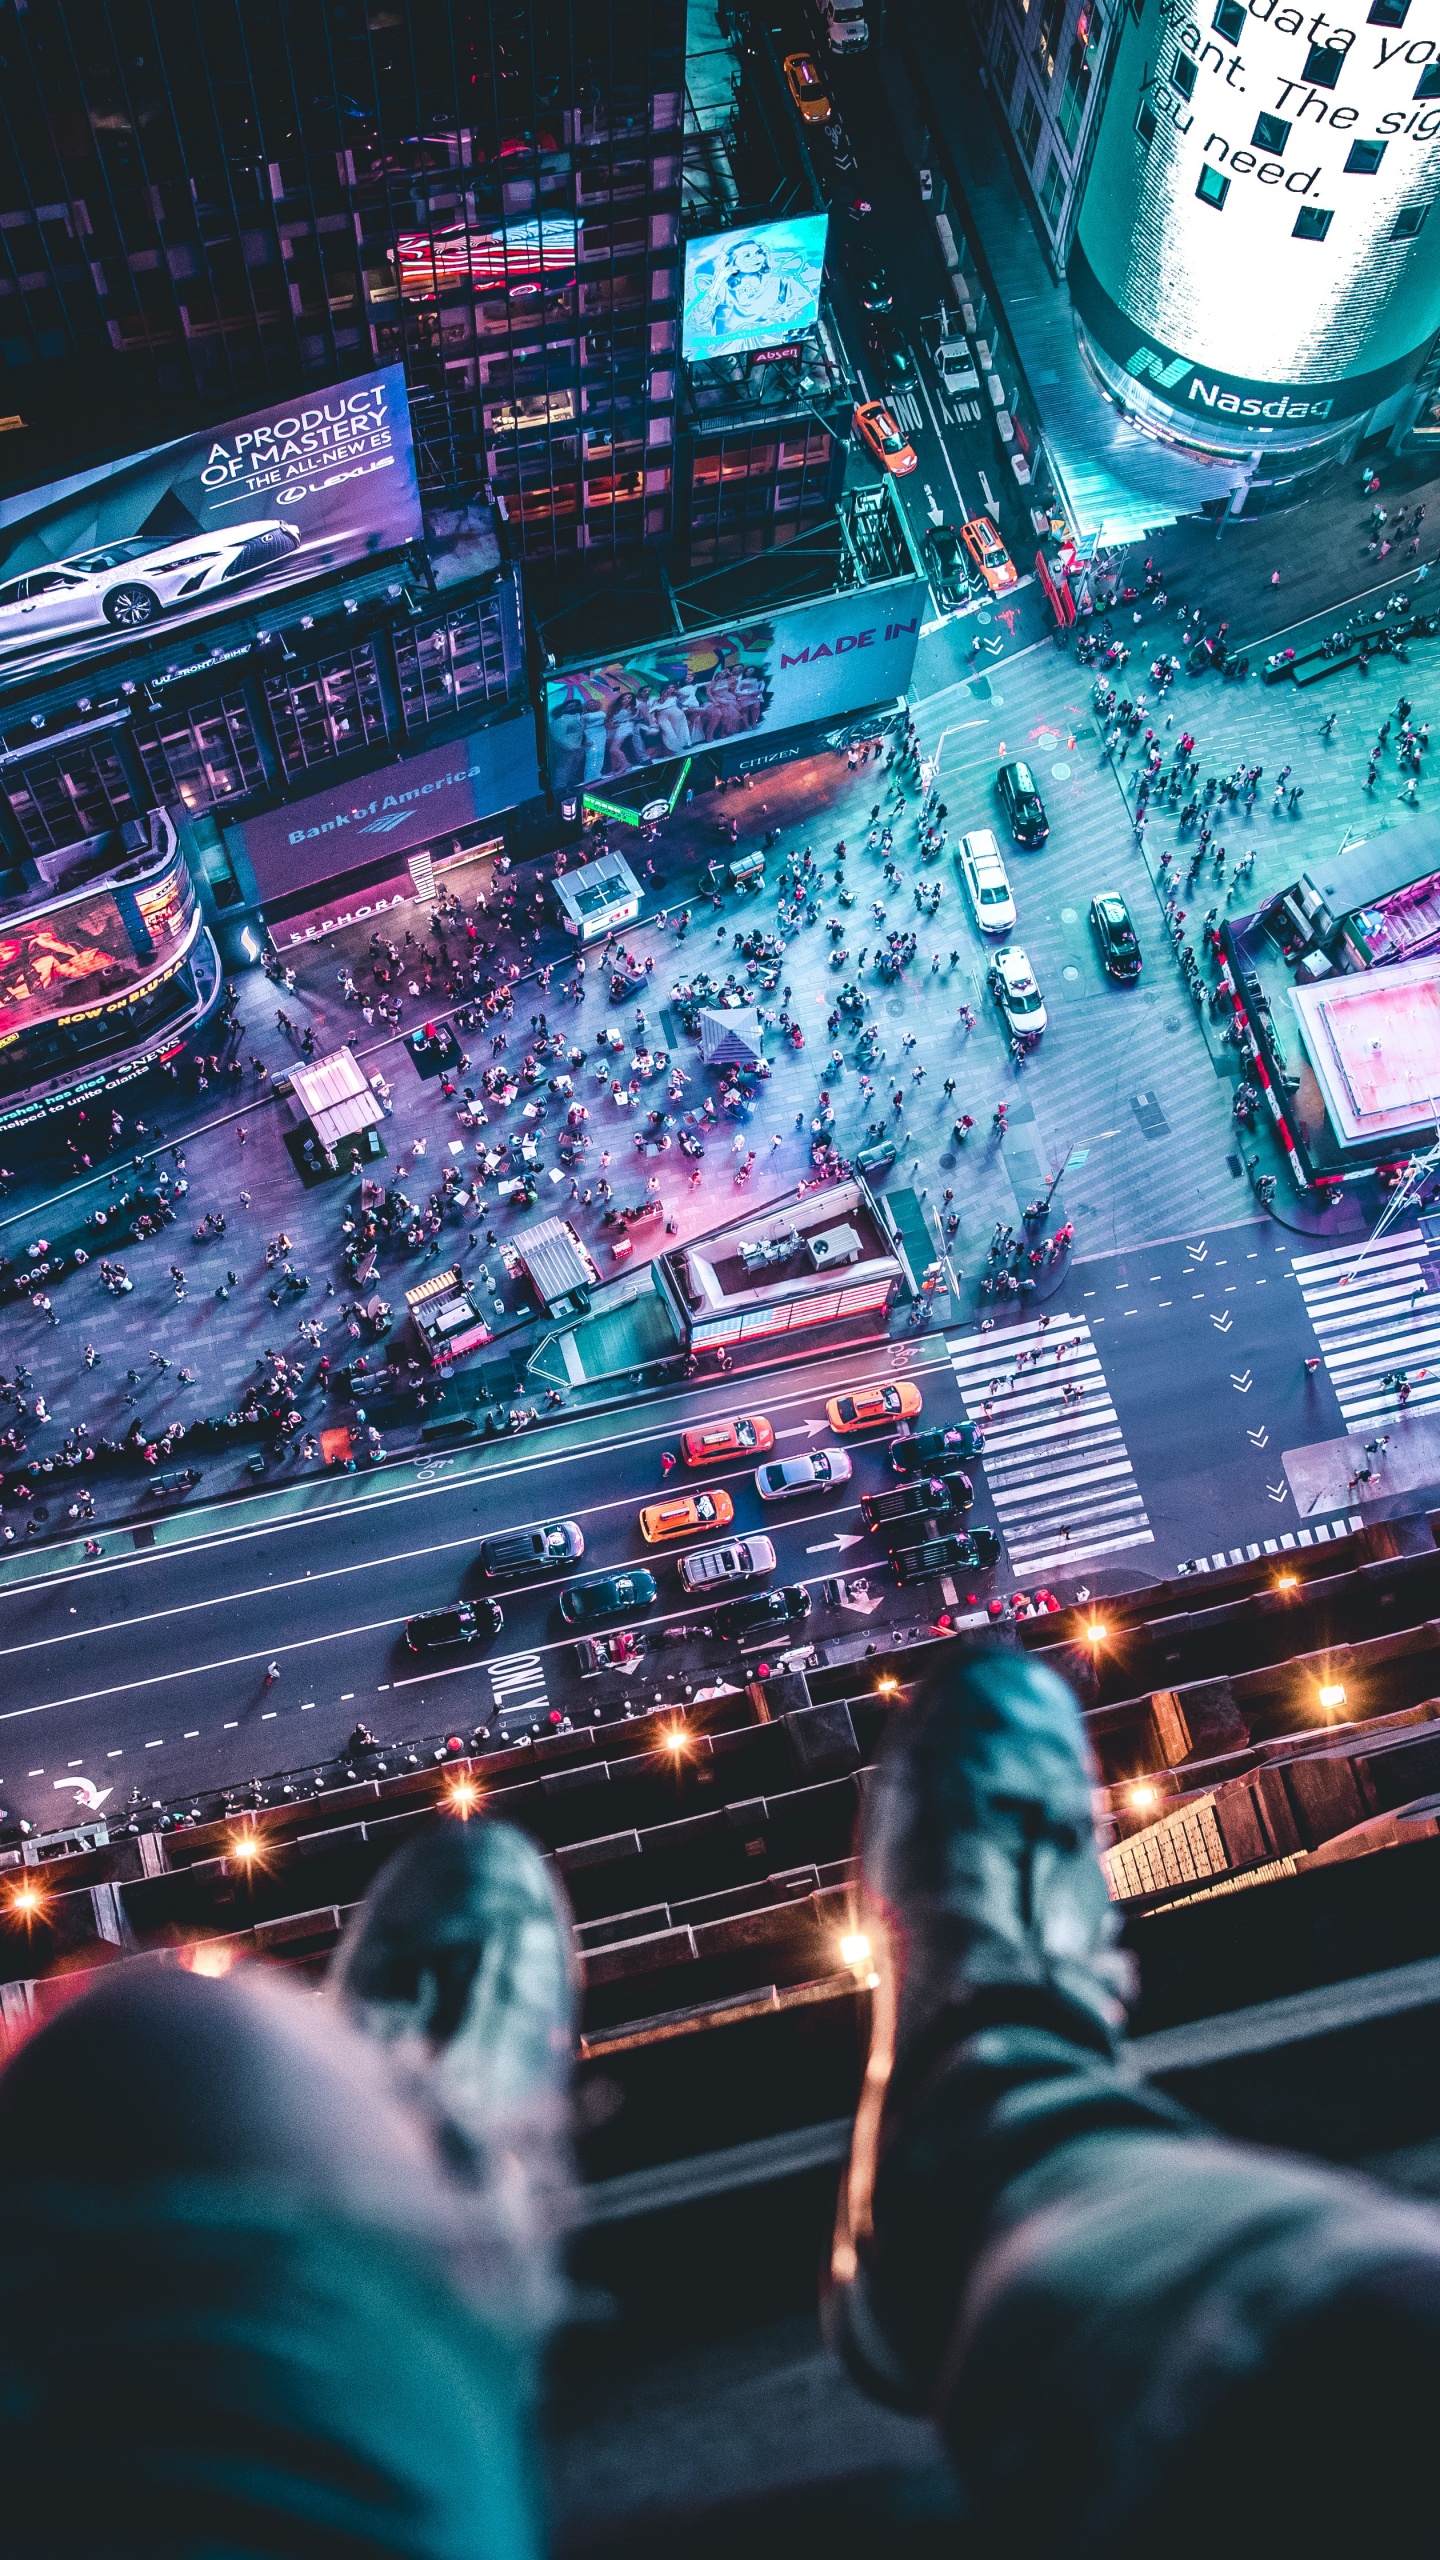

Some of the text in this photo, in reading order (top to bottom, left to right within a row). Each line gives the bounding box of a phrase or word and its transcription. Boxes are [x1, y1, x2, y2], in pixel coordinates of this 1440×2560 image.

[1373, 37, 1440, 69] yo
[1276, 76, 1360, 130] The
[1139, 60, 1322, 198] you need.
[755, 348, 798, 363] Absen
[1188, 377, 1335, 419] Nasdaq
[200, 405, 389, 486] OF MASTERY
[208, 385, 386, 464] A PRODUCT
[245, 430, 392, 491] THE ALL-NEW ES
[308, 455, 395, 493] LEXUS
[780, 617, 918, 669] MADE IN
[739, 747, 800, 770] CITIZEN
[288, 765, 481, 846] Bank of America
[290, 894, 405, 944] SEPHORA
[57, 1006, 103, 1027] NOW
[106, 998, 128, 1013] ON
[131, 1036, 181, 1069] NEWS
[48, 1103, 65, 1114] to
[105, 1065, 150, 1090] Giants
[75, 1075, 106, 1093] died
[487, 1654, 550, 1714] ONLY
